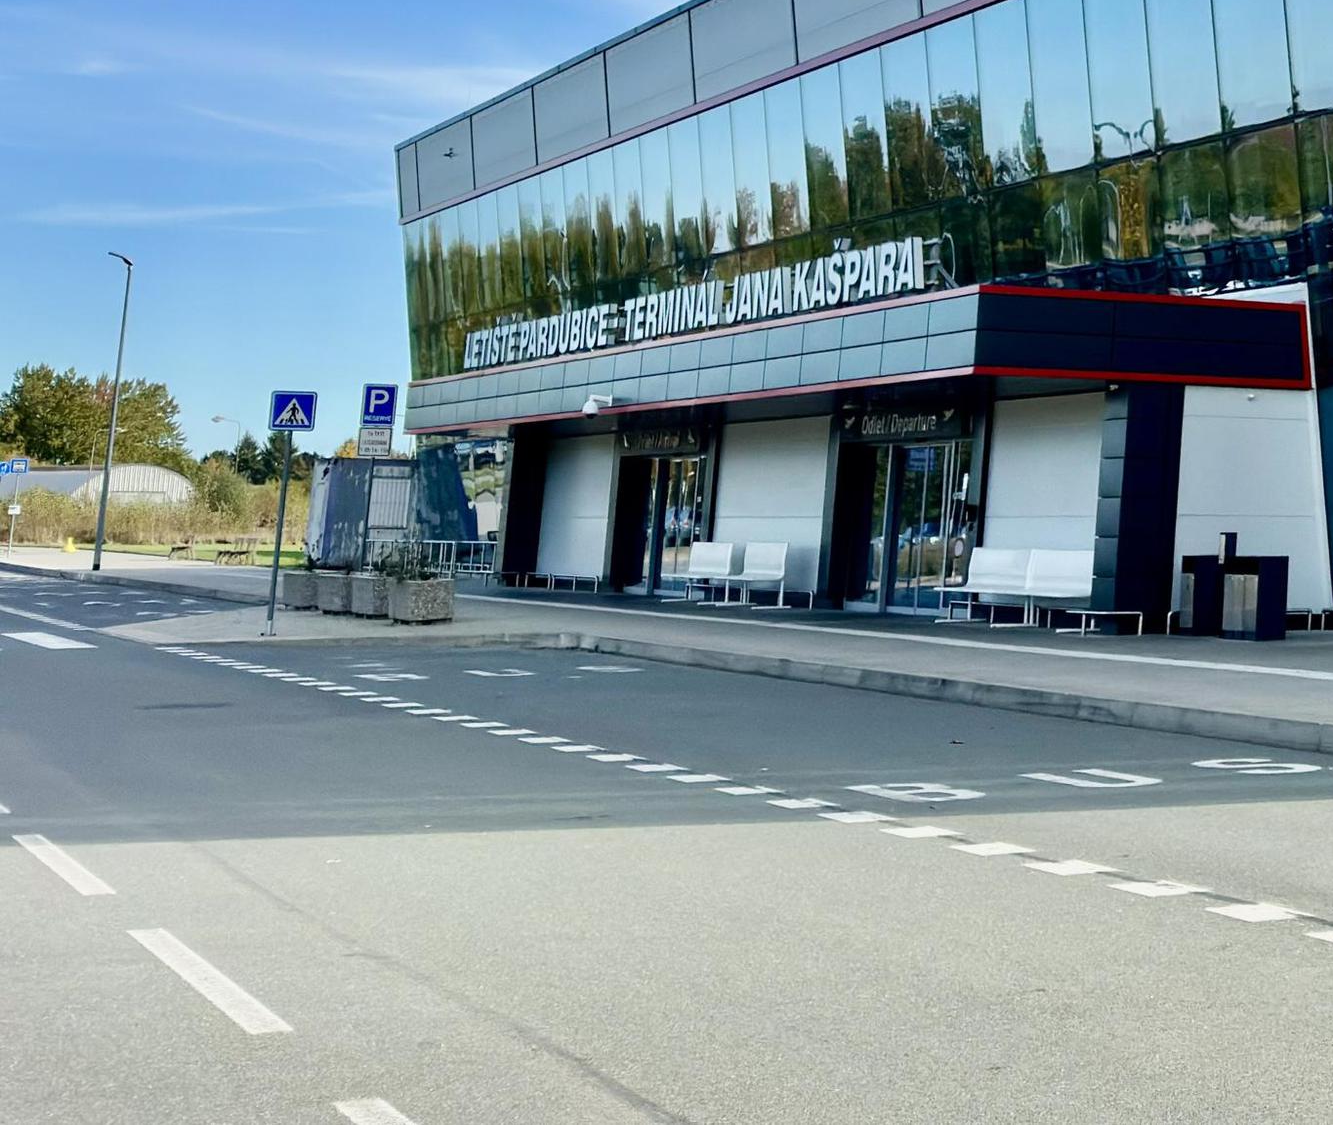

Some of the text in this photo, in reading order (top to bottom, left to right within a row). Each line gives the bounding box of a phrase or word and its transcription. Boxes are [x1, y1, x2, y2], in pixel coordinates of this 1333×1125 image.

[464, 313, 519, 369] LETIŠTĚ
[518, 304, 610, 358] PARDUBICE
[624, 279, 720, 342] TERMINAL
[725, 266, 786, 324] JANA
[793, 236, 917, 312] KAŠPARA
[369, 389, 390, 413] P
[861, 415, 885, 435] Odlet
[891, 413, 937, 437] Departure
[844, 758, 1322, 803] BUS
